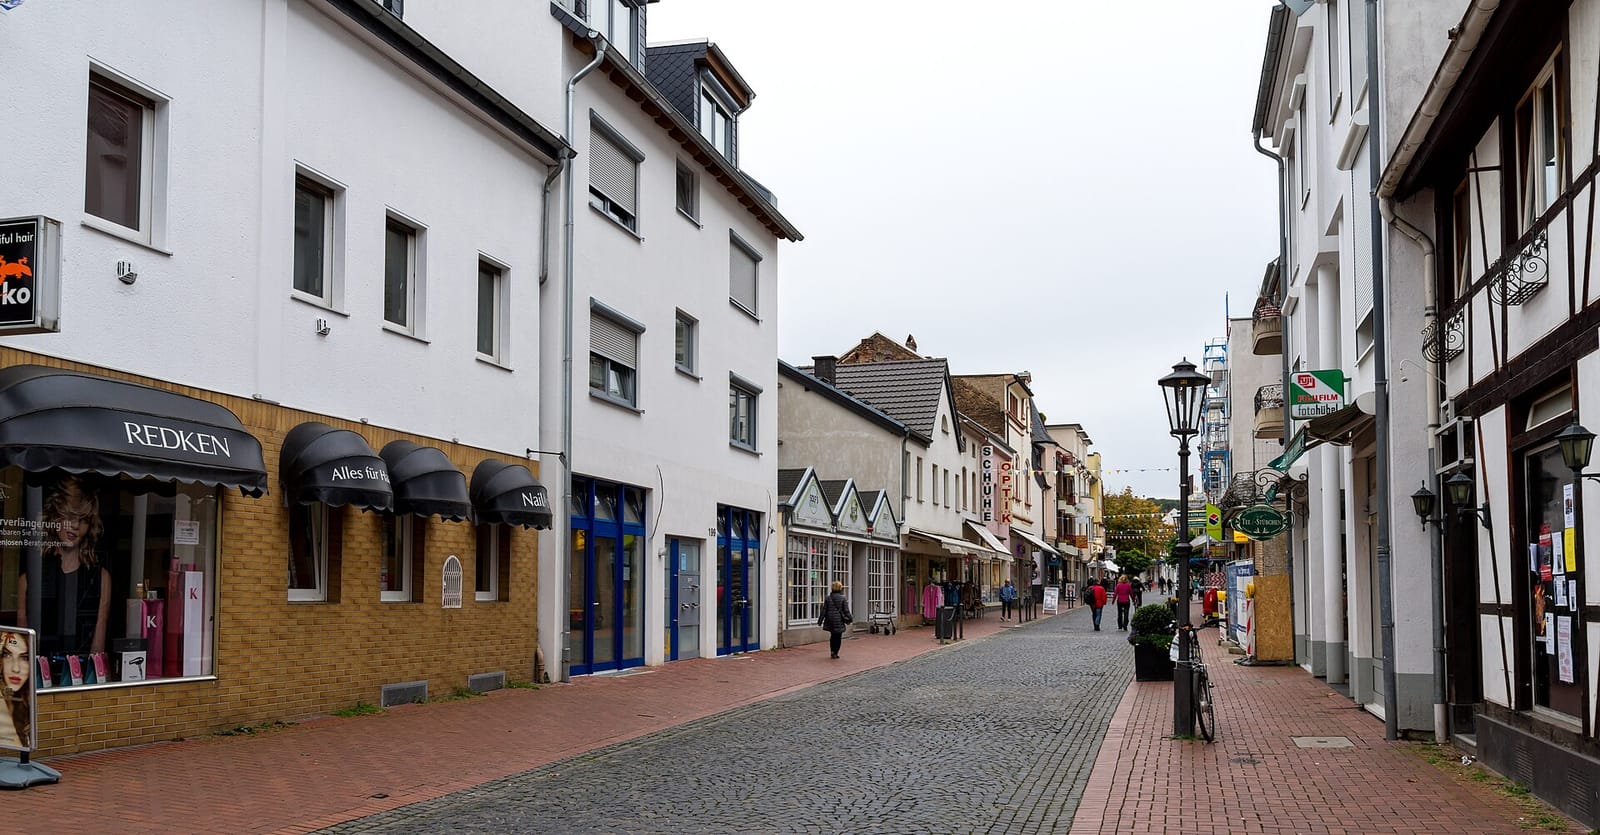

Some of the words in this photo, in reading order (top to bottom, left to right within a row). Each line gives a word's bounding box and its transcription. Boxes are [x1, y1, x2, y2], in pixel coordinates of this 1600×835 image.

[15, 231, 34, 243] hair
[2, 281, 31, 305] ko
[1298, 403, 1338, 416] fotohübel
[123, 420, 231, 458] REDKEN
[332, 466, 364, 481] Alles
[365, 466, 379, 480] für
[983, 447, 992, 521] SCHUHE
[1002, 463, 1011, 522] OPTIK
[63, 521, 72, 530] !!!
[21, 529, 32, 537] Sie
[708, 528, 716, 537] 199
[190, 587, 198, 600] K
[147, 616, 157, 628] K
